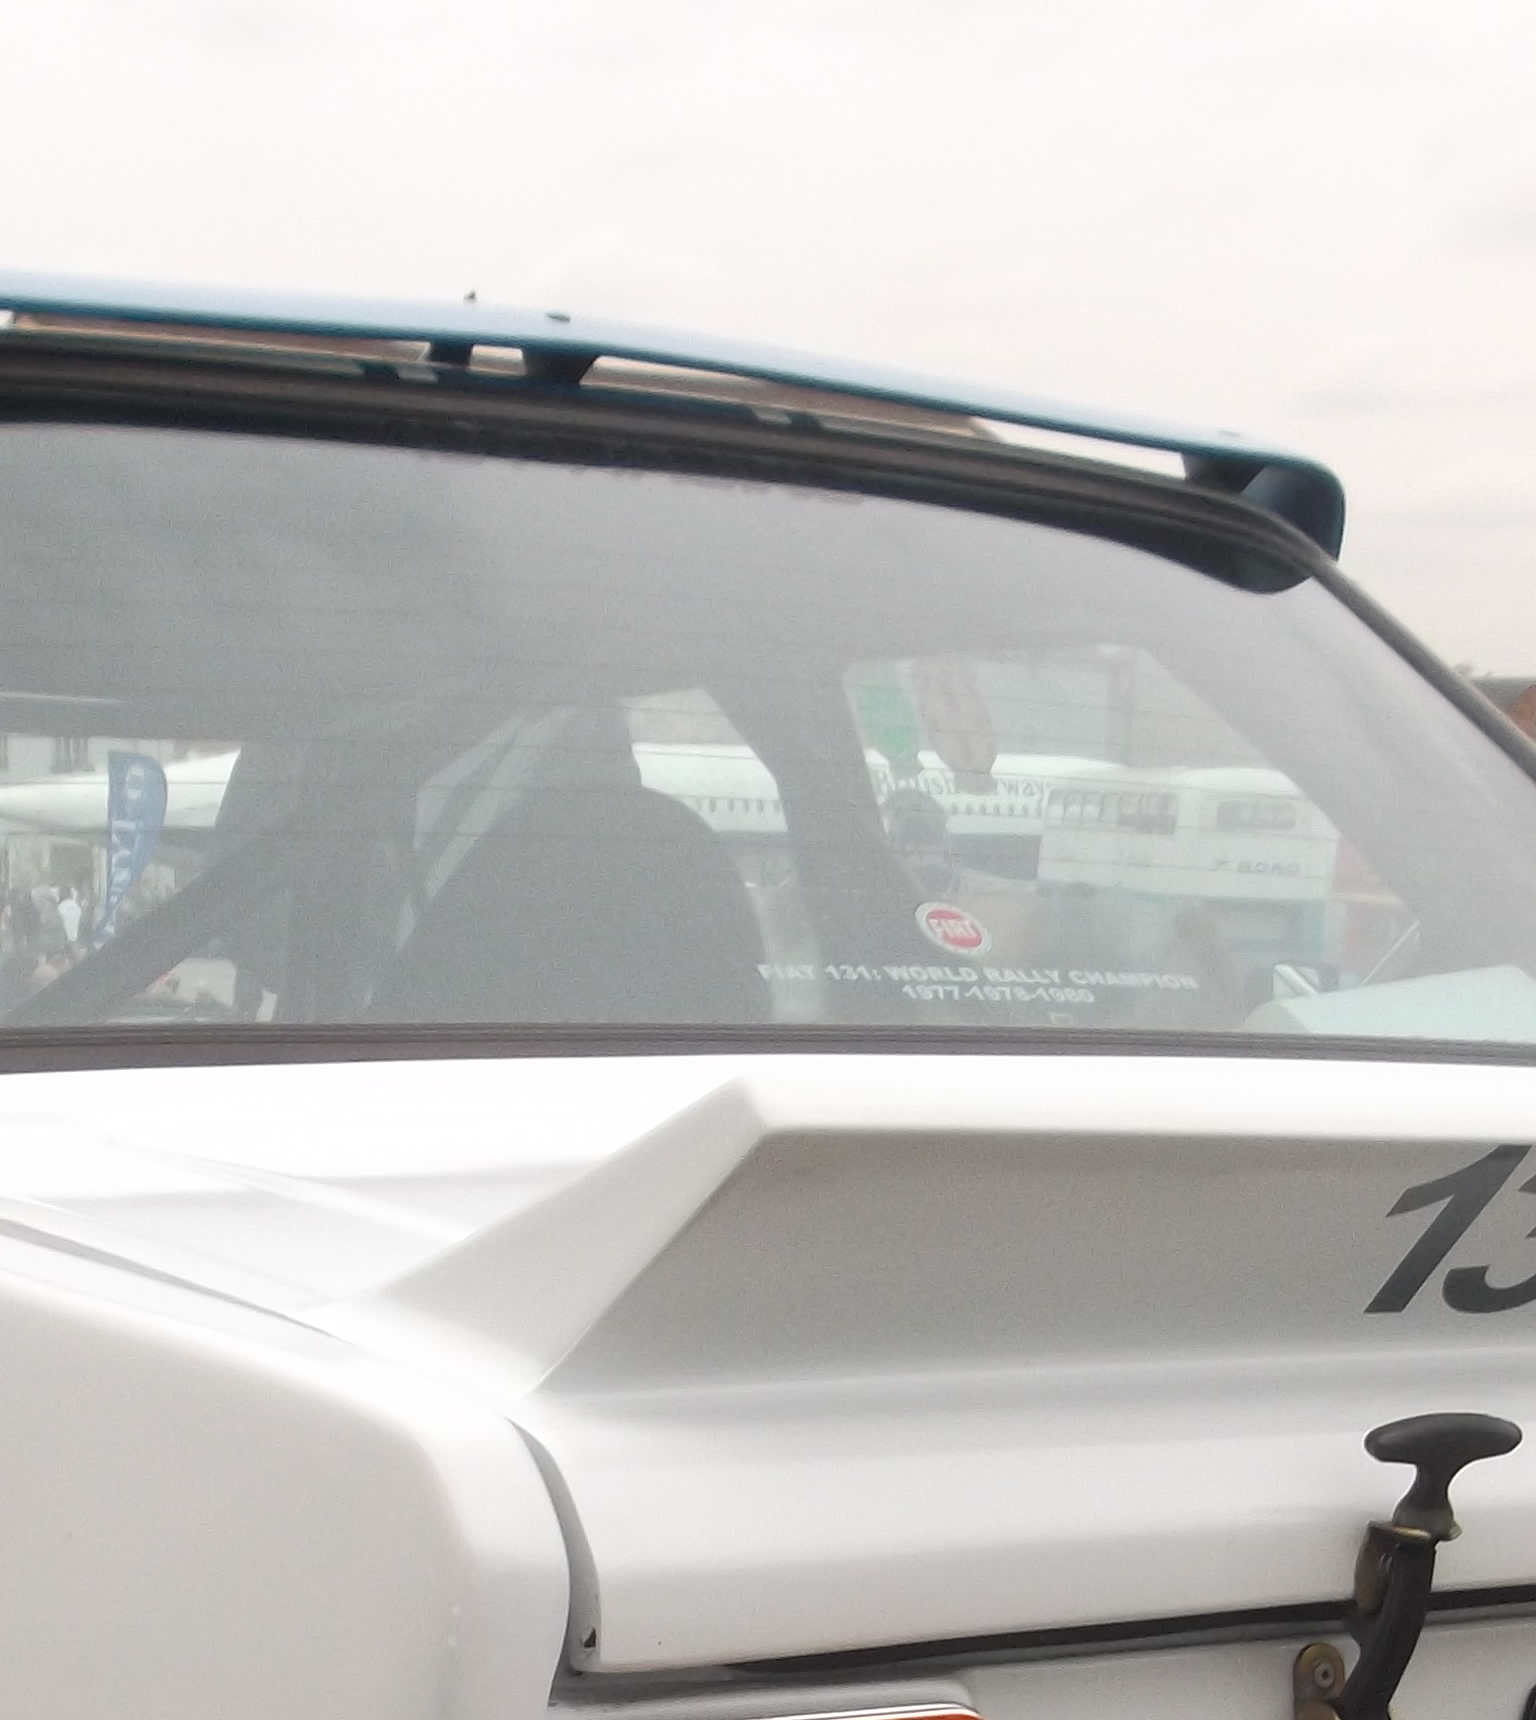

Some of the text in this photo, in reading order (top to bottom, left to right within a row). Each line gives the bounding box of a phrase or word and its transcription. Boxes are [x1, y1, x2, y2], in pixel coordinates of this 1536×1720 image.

[757, 963, 815, 981] FIAT
[884, 965, 979, 983] WORLD
[983, 967, 1061, 984] RALLY
[1068, 969, 1200, 990] CHAMPION
